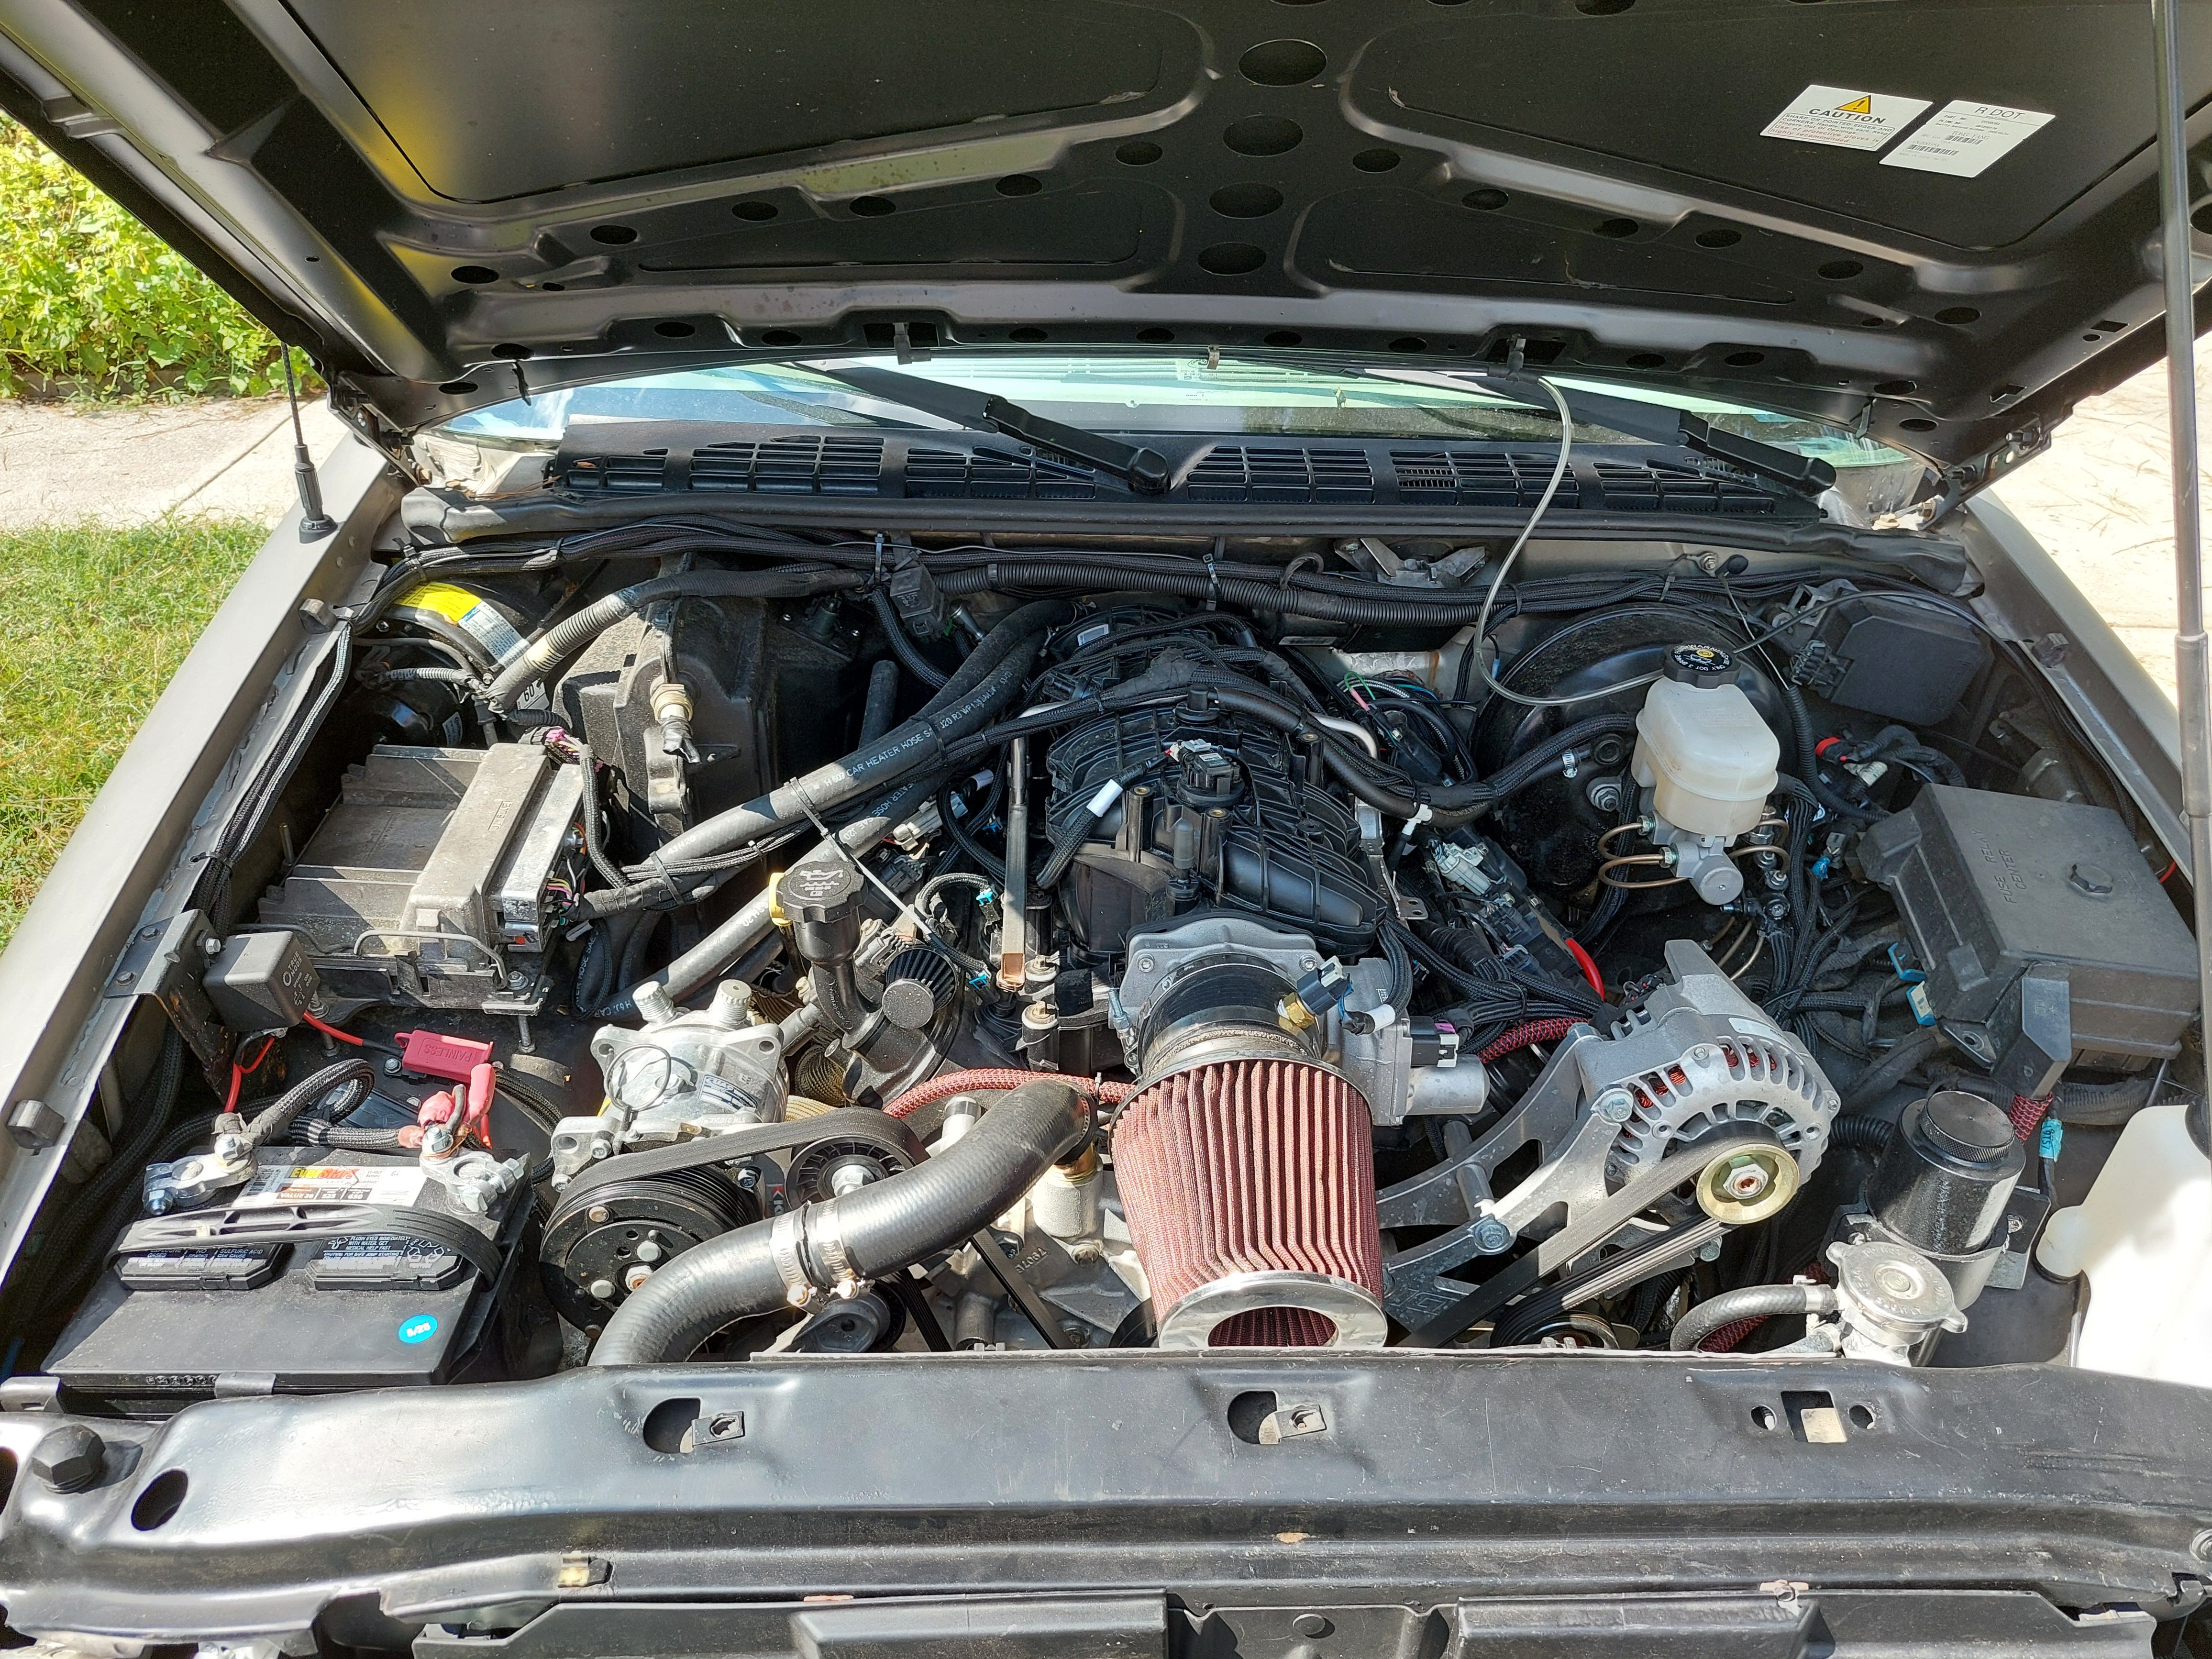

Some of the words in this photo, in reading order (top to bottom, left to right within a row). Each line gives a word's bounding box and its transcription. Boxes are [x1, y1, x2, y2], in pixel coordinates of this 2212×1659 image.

[1808, 108, 1886, 124] CAUTION
[1990, 109, 2025, 119] DOT
[1802, 129, 1841, 138] protective
[483, 605, 515, 633] DELPHI
[1690, 644, 1729, 658] WARNING
[824, 778, 831, 787] H
[846, 763, 865, 777] CAR
[865, 746, 901, 768] HEATER
[900, 734, 924, 750] HOSE
[940, 717, 953, 729] J20
[960, 704, 972, 715] WP
[496, 803, 511, 818] BLUE
[872, 800, 893, 817] HOSE
[843, 828, 858, 841] J20
[1971, 829, 1997, 863] RELAY
[1999, 849, 2026, 890] CENTER
[1994, 875, 2017, 903] FUSE
[288, 951, 299, 971] TRUE
[578, 955, 589, 979] HOSE
[586, 936, 597, 954] SAE
[290, 956, 302, 977] MODS
[424, 1044, 473, 1062] PAINLESS
[289, 1167, 360, 1179] EverStart
[1862, 1246, 1878, 1257] DO
